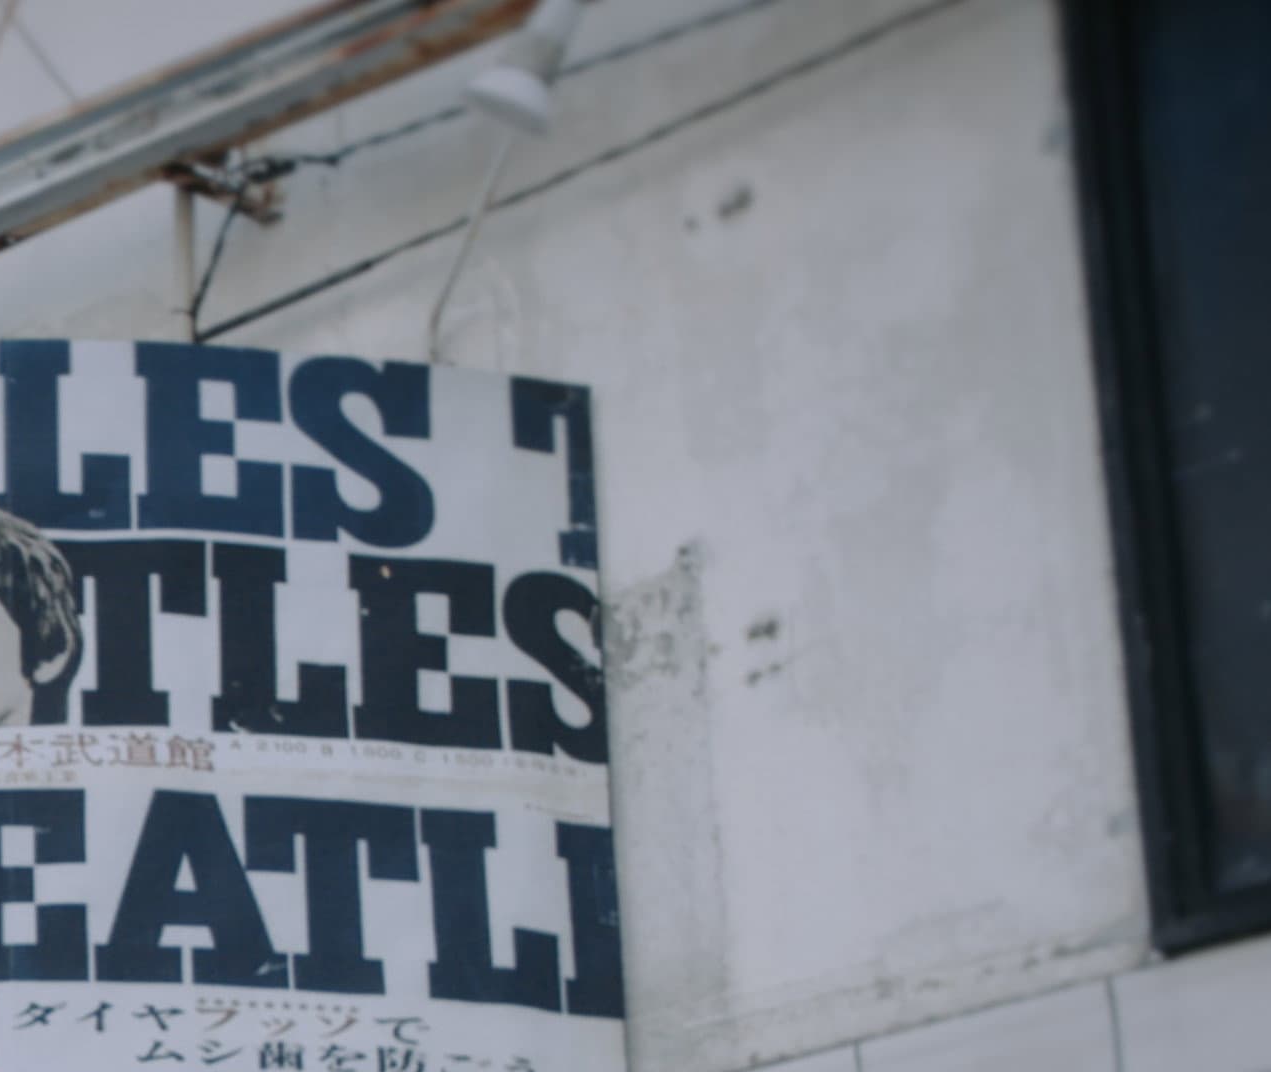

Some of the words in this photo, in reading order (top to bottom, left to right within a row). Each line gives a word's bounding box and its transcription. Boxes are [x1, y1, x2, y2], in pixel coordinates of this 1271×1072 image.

[12, 1000, 430, 1046] ダイヤフッソで
